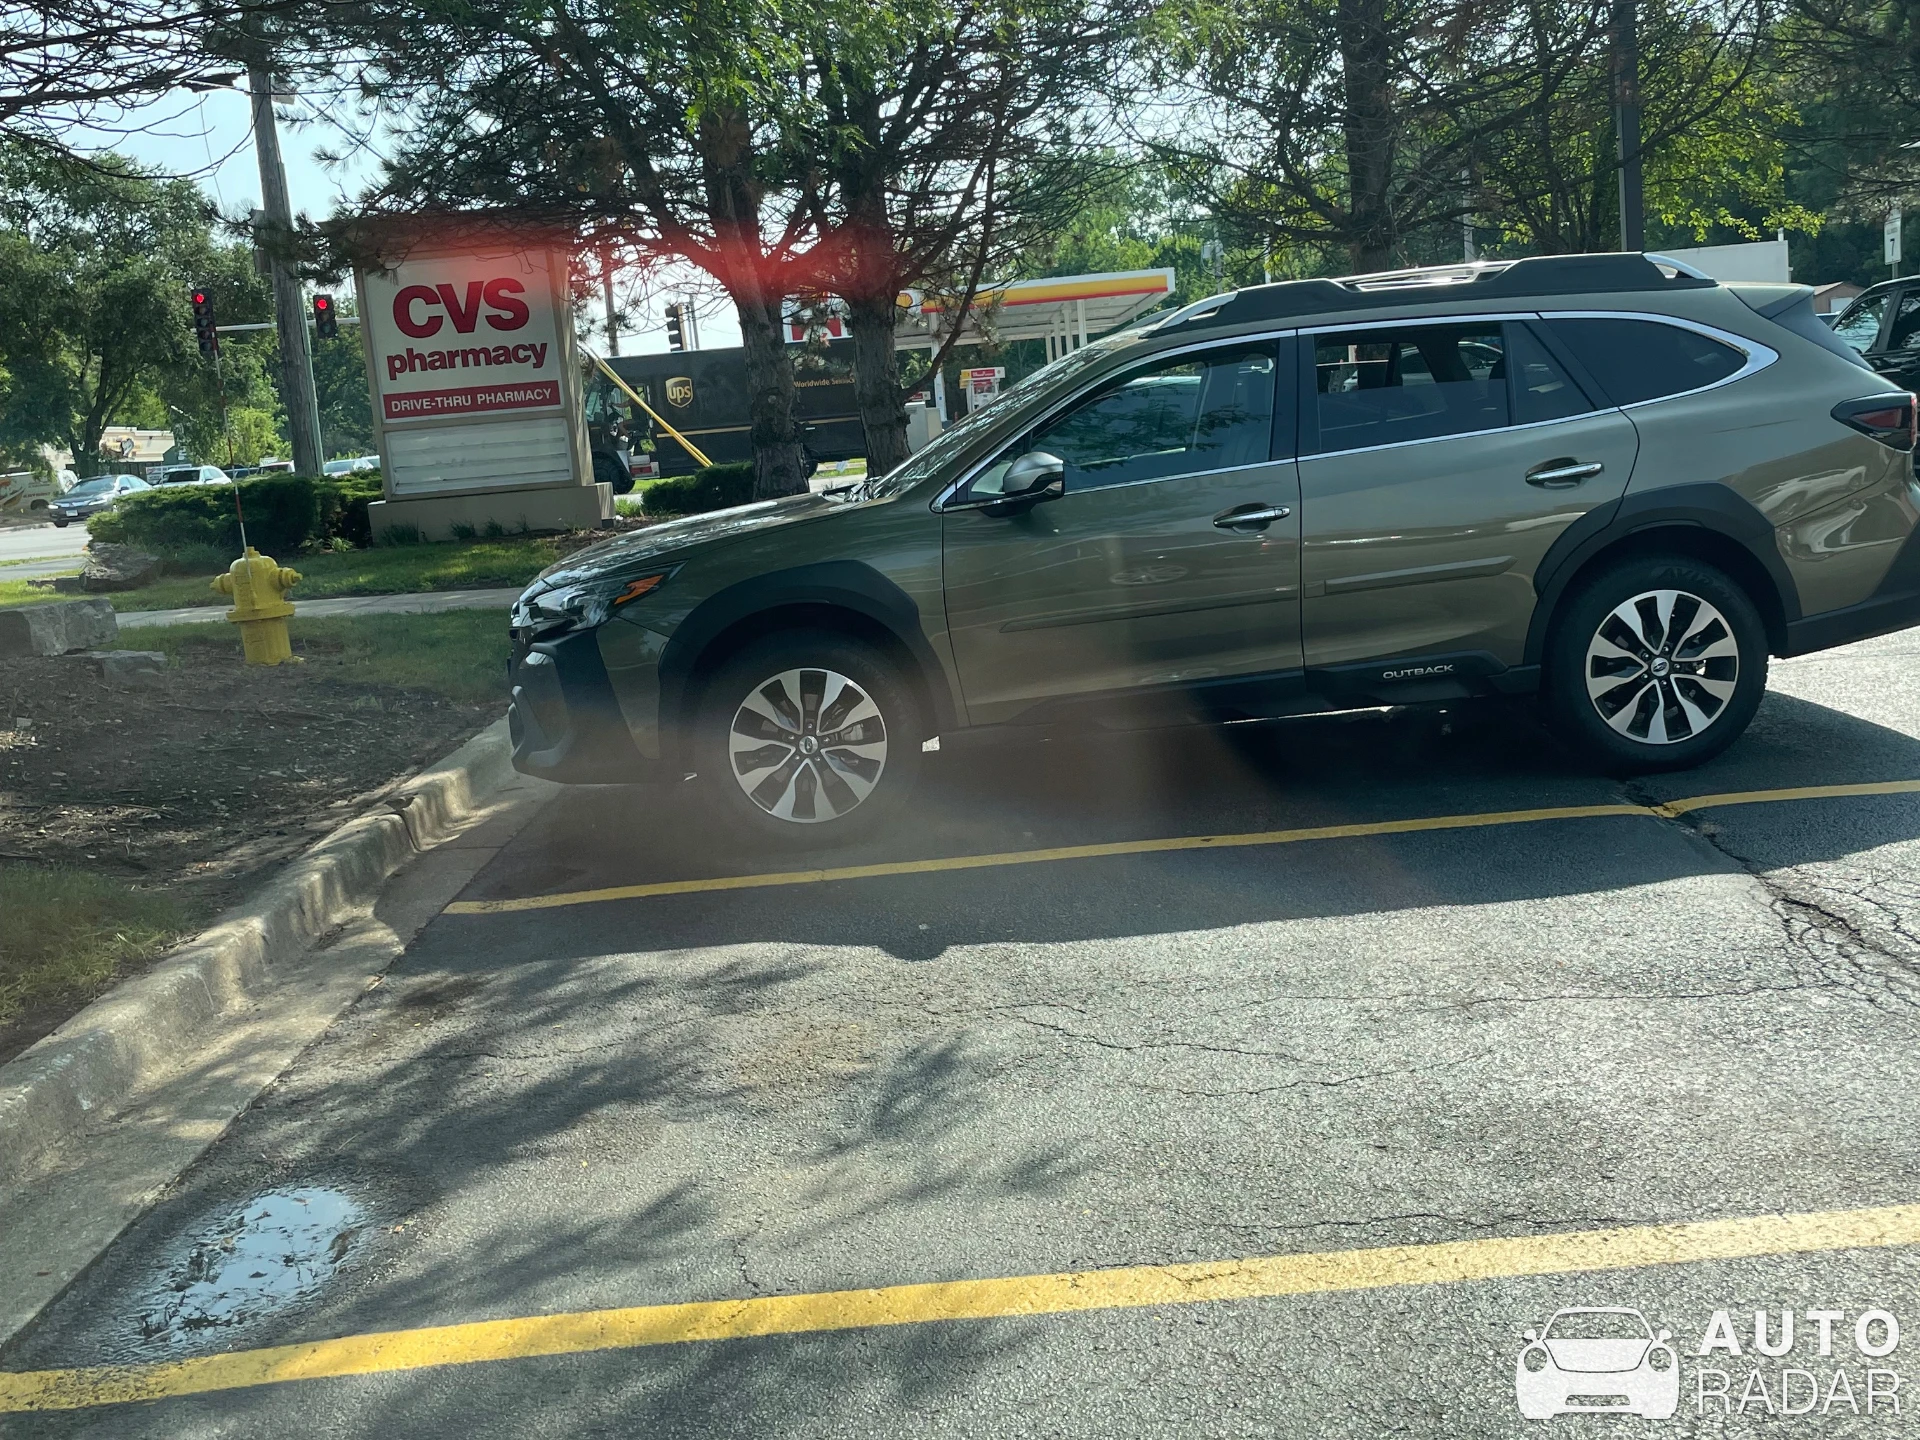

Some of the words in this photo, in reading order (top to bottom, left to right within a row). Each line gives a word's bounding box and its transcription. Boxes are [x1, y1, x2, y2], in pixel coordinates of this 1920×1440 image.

[1890, 238, 1895, 257] 7
[393, 277, 530, 338] CVS
[387, 342, 548, 381] pharmacy
[794, 379, 830, 388] Worldwide
[391, 395, 472, 412] DRIVE-THRU
[477, 388, 552, 405] PHARMACY
[669, 386, 691, 403] ups
[1382, 664, 1454, 679] OUTBACK
